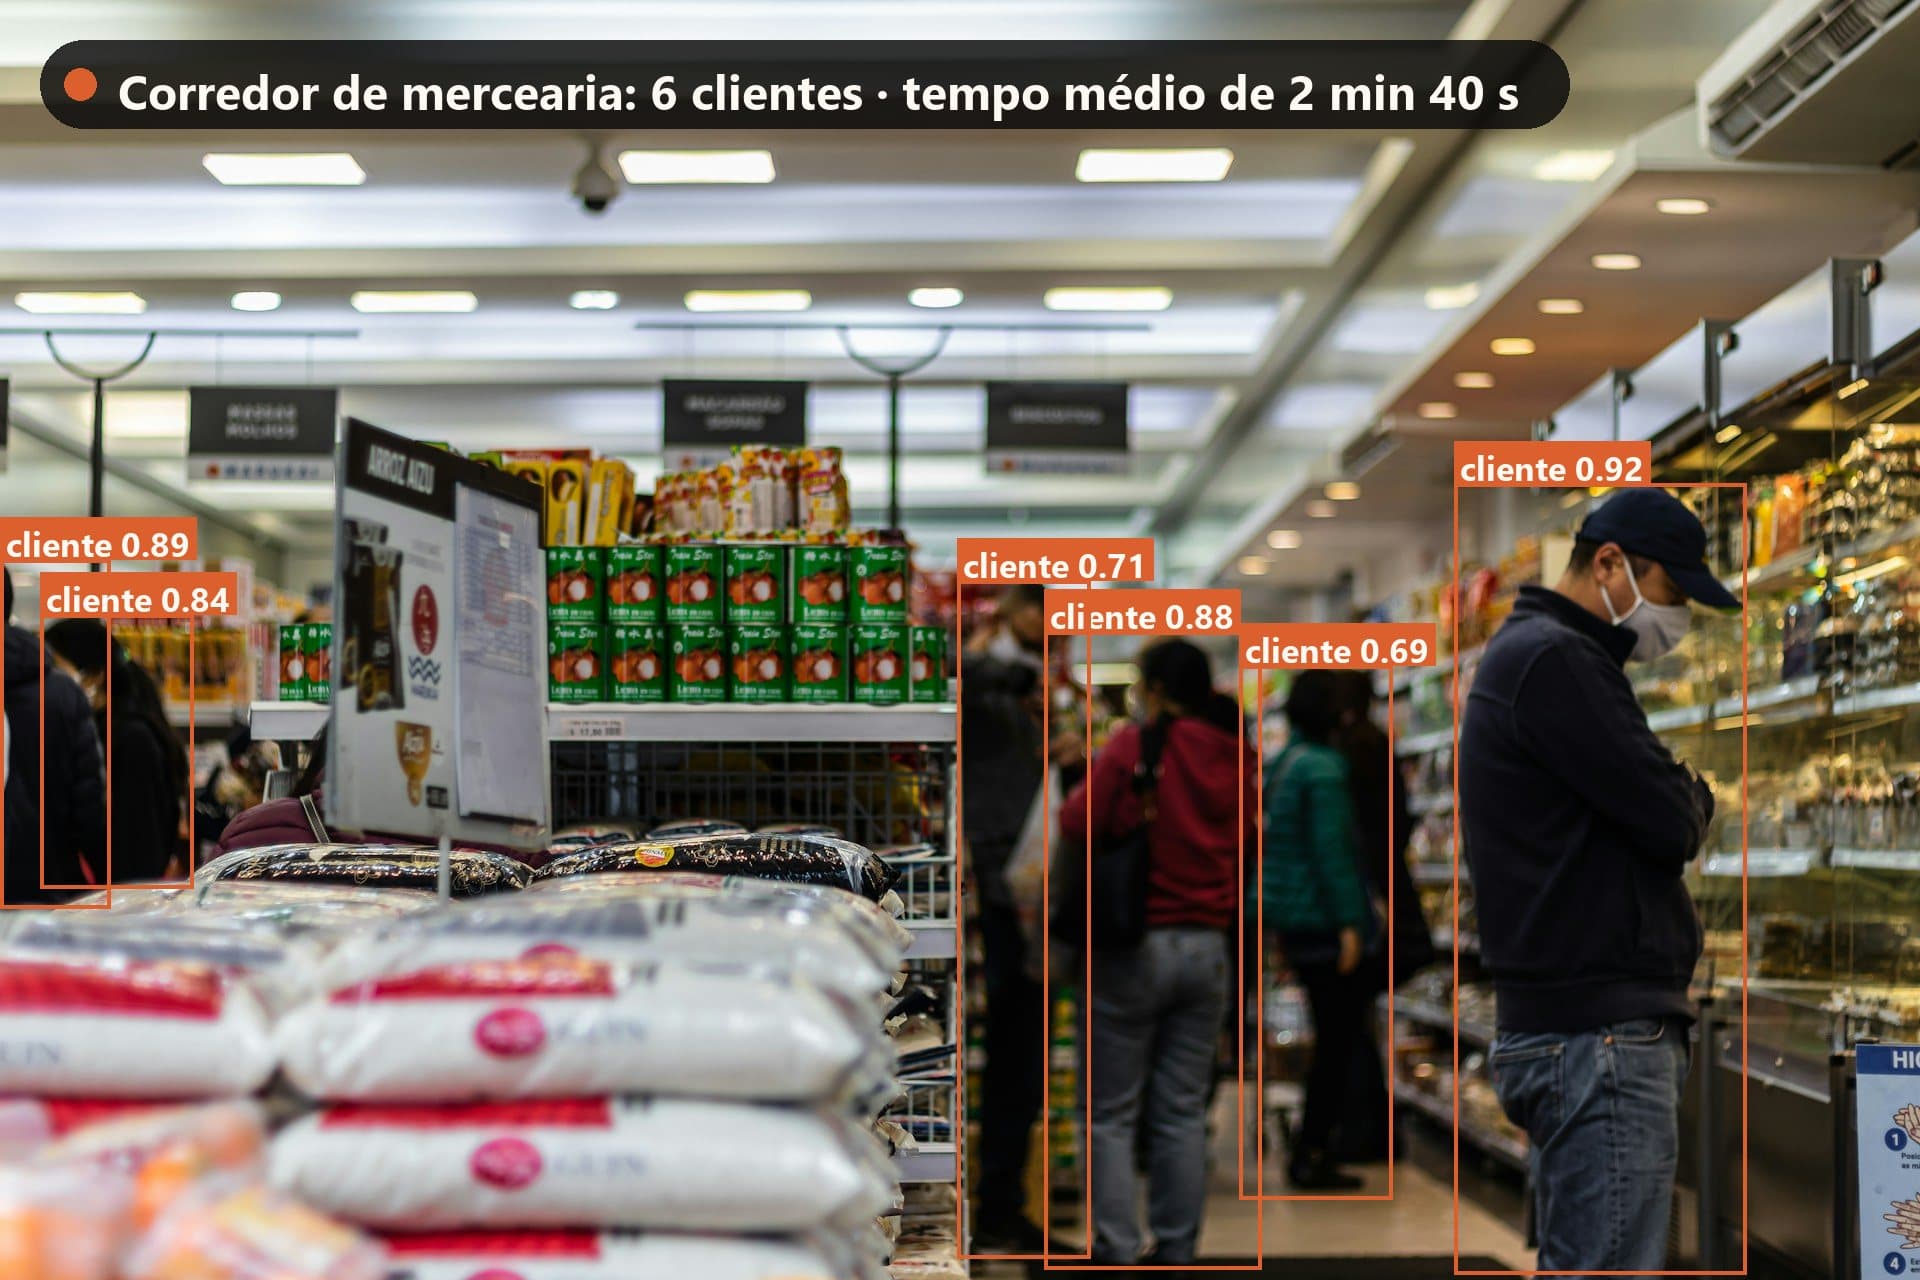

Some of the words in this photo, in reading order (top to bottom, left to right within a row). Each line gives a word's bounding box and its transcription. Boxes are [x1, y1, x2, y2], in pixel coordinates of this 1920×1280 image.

[368, 444, 407, 486] ARROZ
[406, 458, 435, 495] AIZU
[1891, 1133, 1900, 1147] 1
[1889, 1256, 1900, 1271] 4
